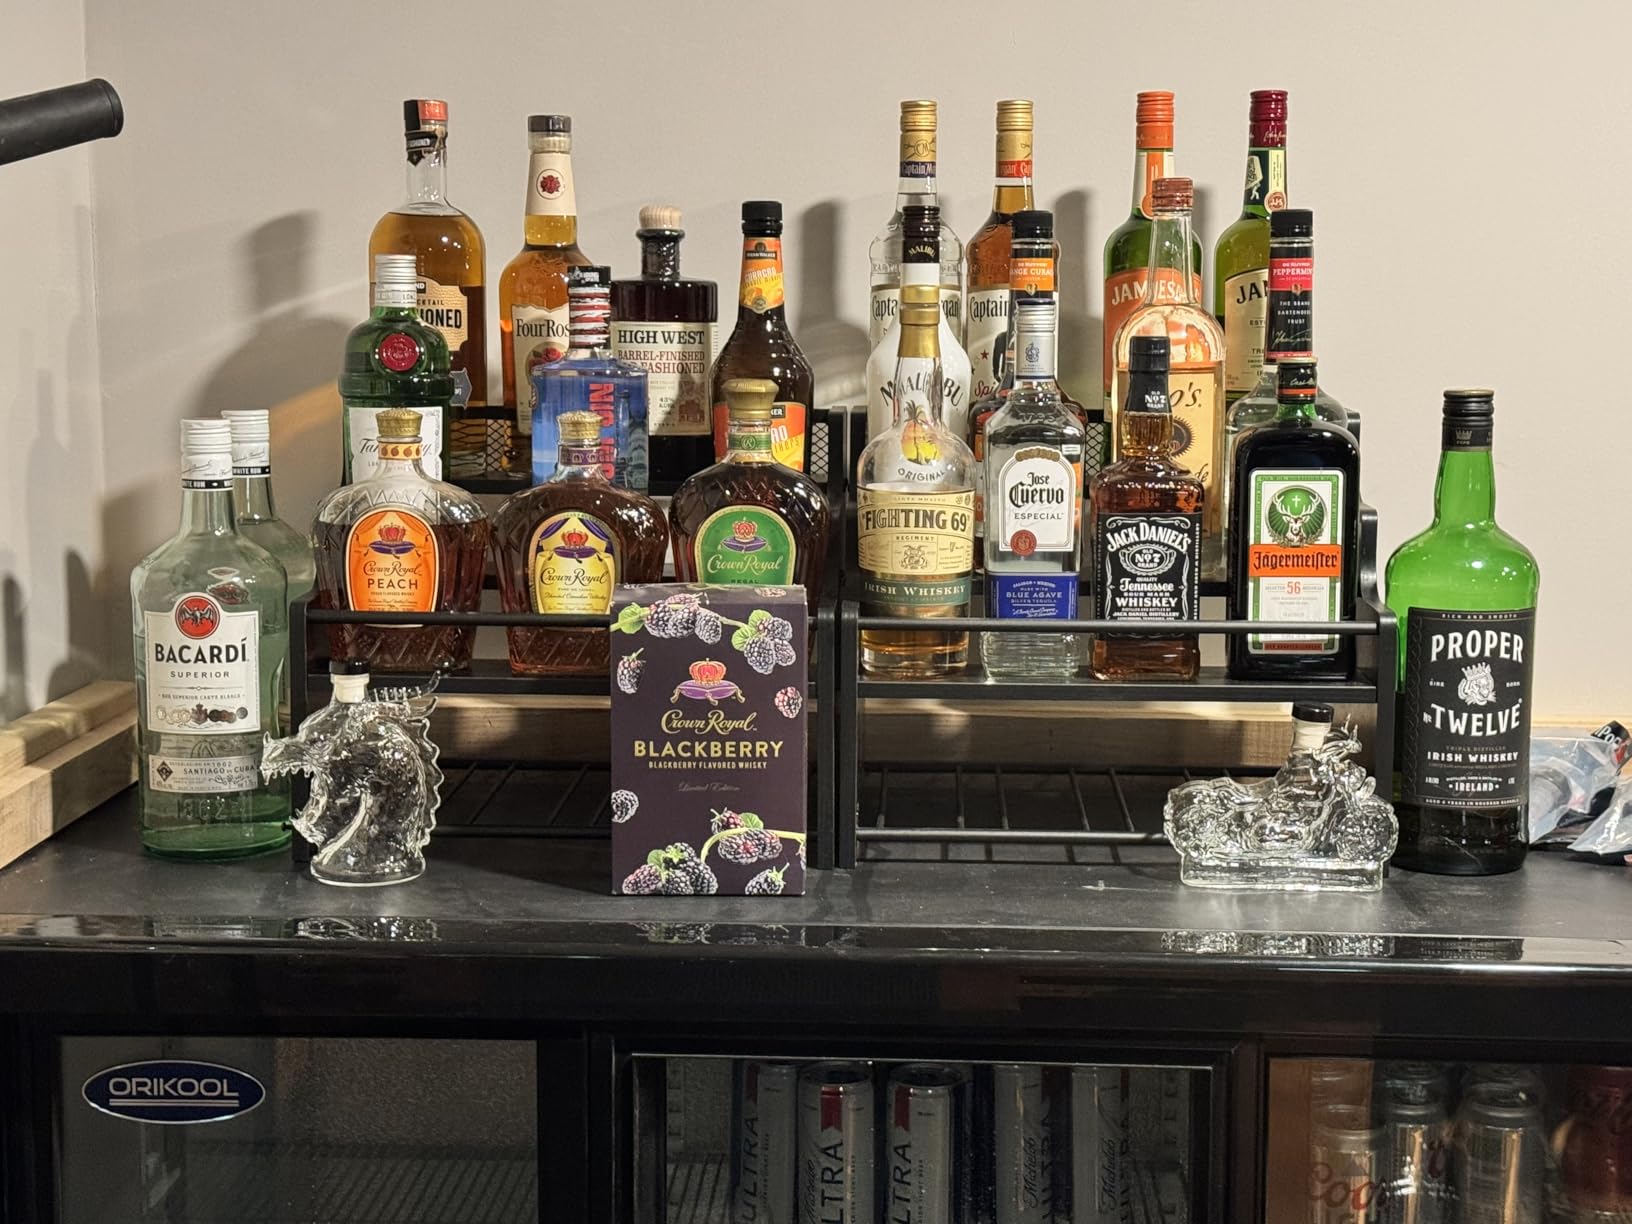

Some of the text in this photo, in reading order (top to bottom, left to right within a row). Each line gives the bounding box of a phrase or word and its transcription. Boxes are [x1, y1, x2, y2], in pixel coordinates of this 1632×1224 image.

[908, 246, 935, 258] MALIBU
[872, 295, 898, 321] Capta
[516, 319, 570, 338] Four Ros
[618, 330, 705, 345] HIGH WEST
[618, 350, 705, 361] BARREL-FINISHED
[1027, 472, 1050, 487] Jose
[1009, 481, 1064, 508] Cuervo
[865, 508, 967, 532] FIGHTING 69
[1106, 522, 1191, 554] JACK DANIEL'S
[363, 561, 422, 576] Crown Royal
[707, 554, 783, 575] Crown Royal
[367, 578, 418, 589] PEACH
[541, 567, 609, 586] Crown Royal
[1120, 577, 1174, 591] Tennessee
[865, 582, 967, 596] IRISH WHISKEY
[1287, 581, 1301, 594] 56
[1115, 597, 1178, 607] WHISKEY
[154, 637, 248, 664] BACARDÍ
[1430, 629, 1524, 663] PROPER
[661, 709, 758, 735] Crown Royal
[1431, 702, 1521, 736] TWELVE
[634, 741, 784, 757] BLACKBERRY
[1427, 751, 1519, 763] IRISH WHISKEY
[183, 767, 225, 775] SANTIAGO
[233, 765, 255, 773] CUBA
[649, 761, 767, 769] BLACKBERRY FLAVORED WHISKY
[1455, 782, 1494, 791] IRELAND
[109, 1077, 239, 1097] ORIKOOL
[742, 1116, 759, 1223] ULTRA
[821, 1139, 844, 1224] LTRA
[893, 1141, 912, 1224] LTRA
